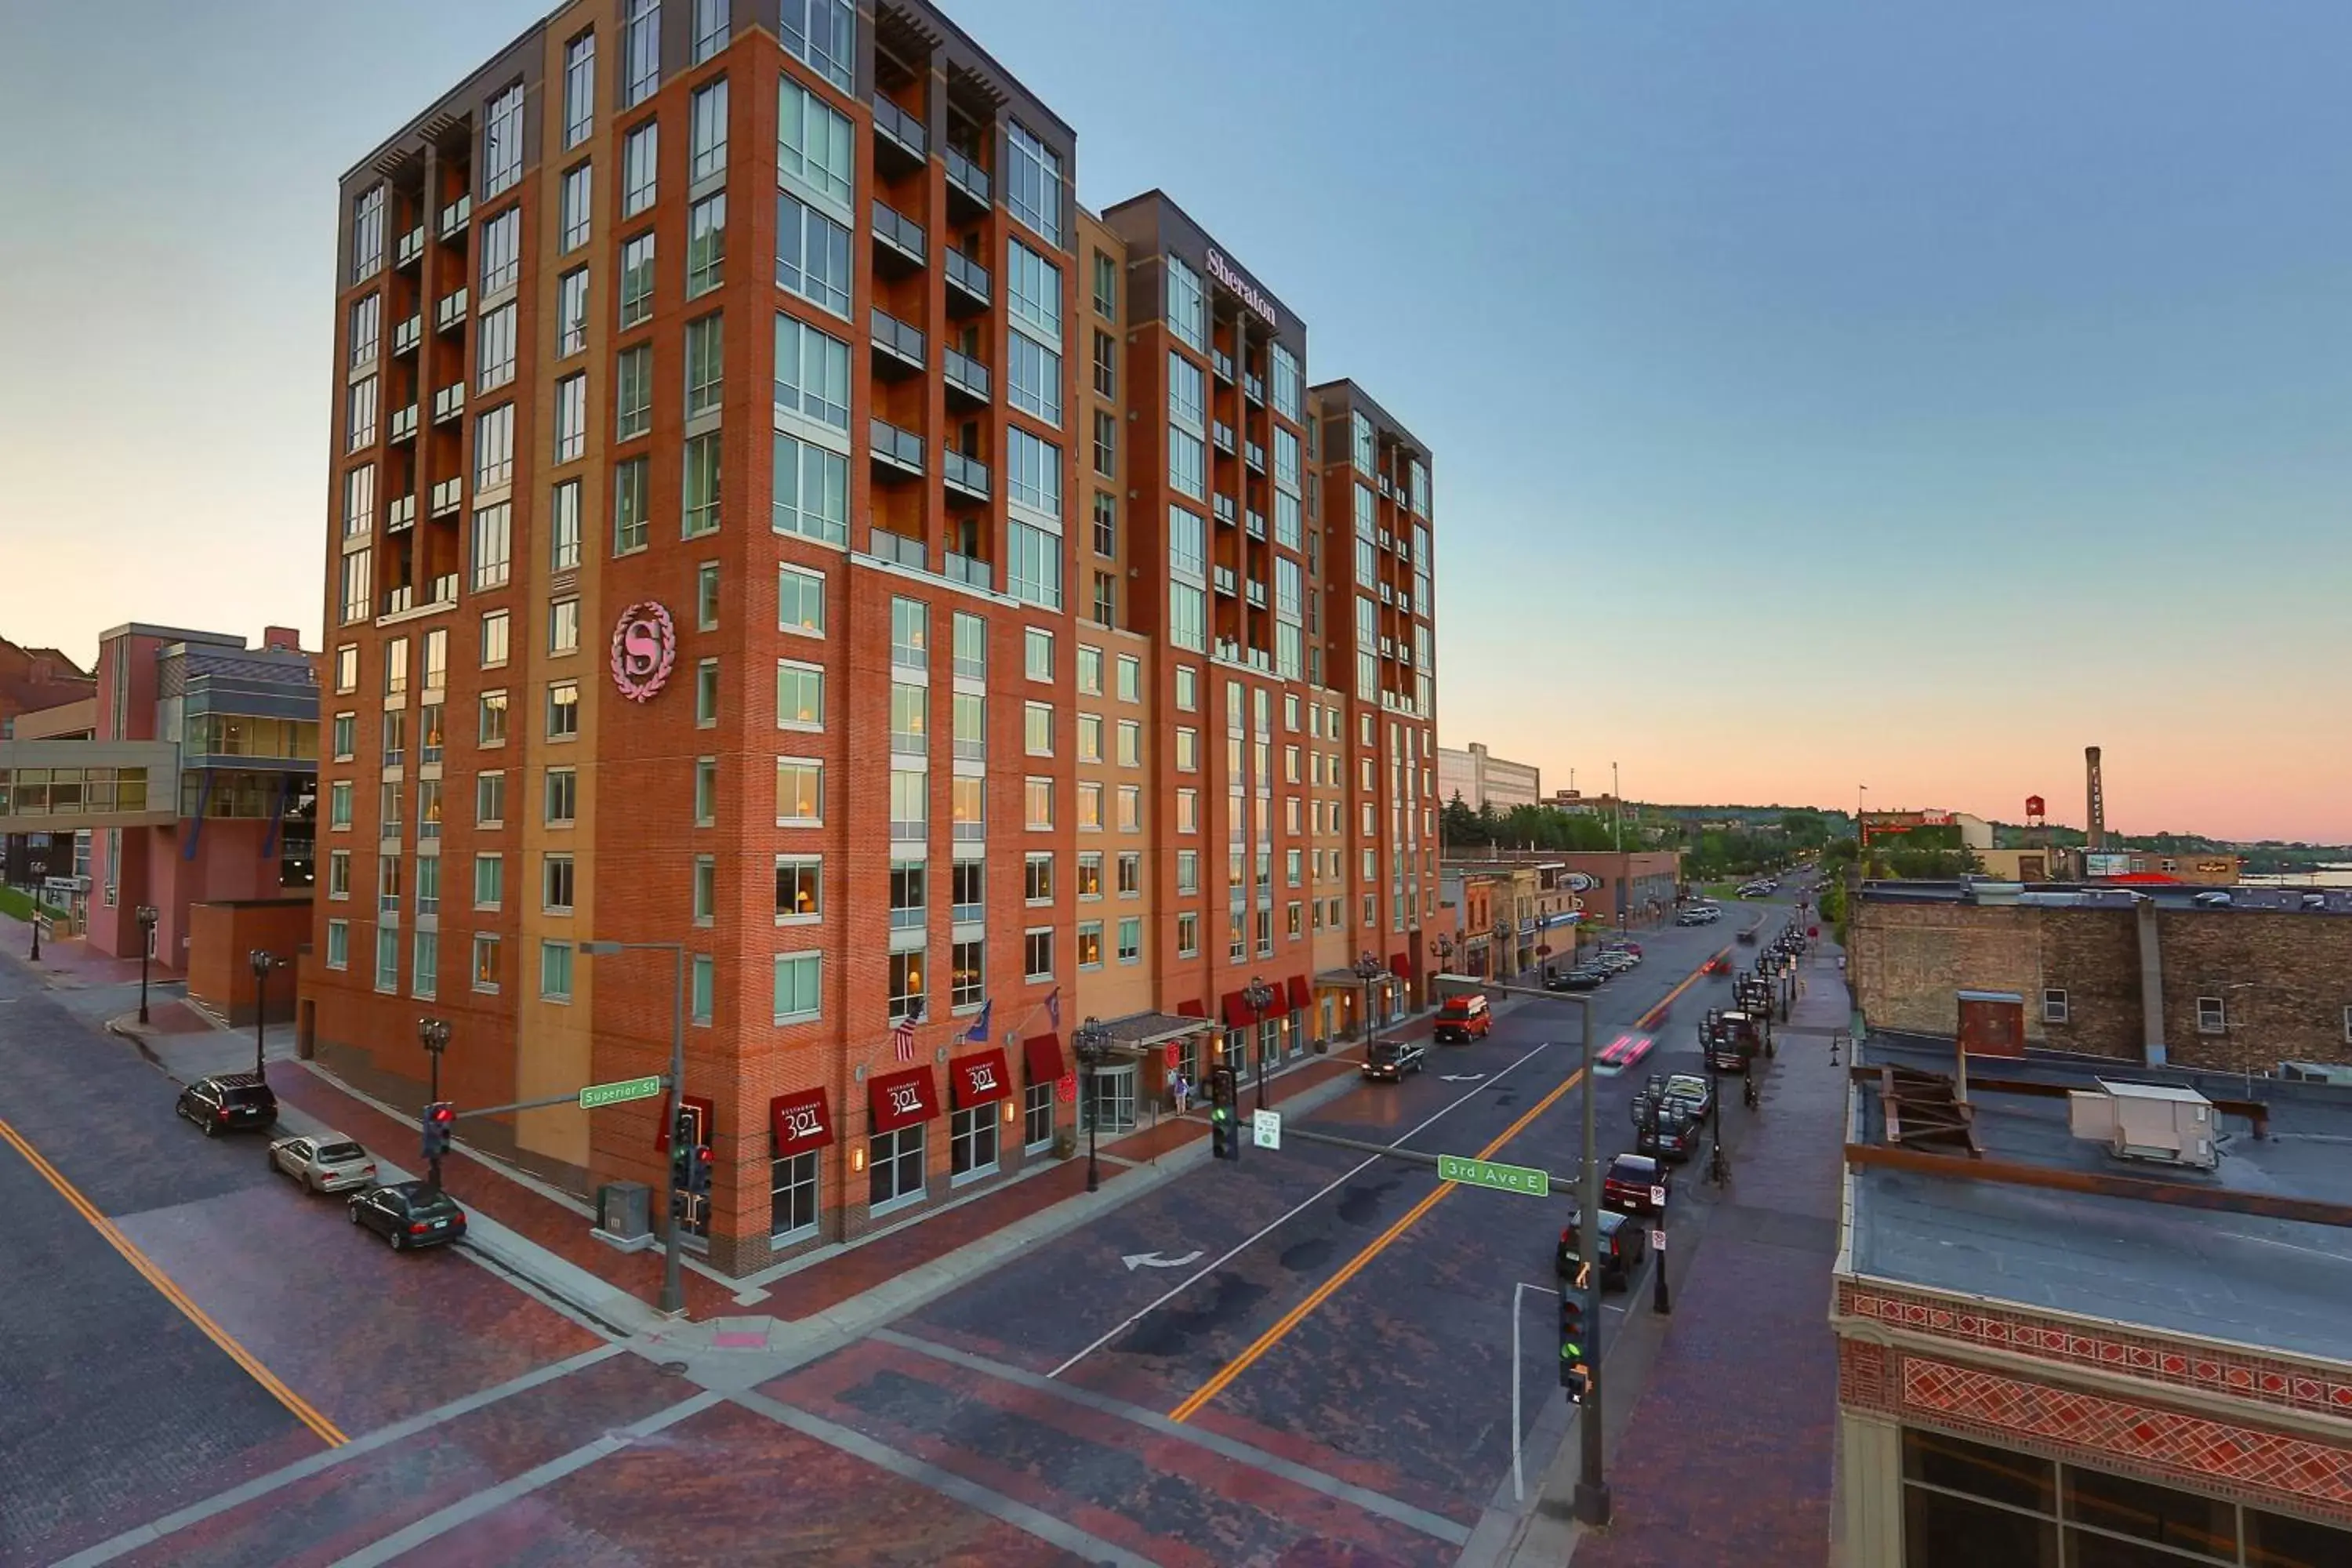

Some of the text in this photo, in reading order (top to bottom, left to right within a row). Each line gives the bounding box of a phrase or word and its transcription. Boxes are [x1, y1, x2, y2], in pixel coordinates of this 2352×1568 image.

[1206, 248, 1276, 327] Sheraton
[626, 619, 661, 676] S
[586, 1081, 656, 1102] Superior St
[968, 1067, 993, 1094] 301
[890, 1087, 918, 1117] 301
[785, 1109, 818, 1142] 301
[1448, 1163, 1538, 1189] 3rd Ave E
